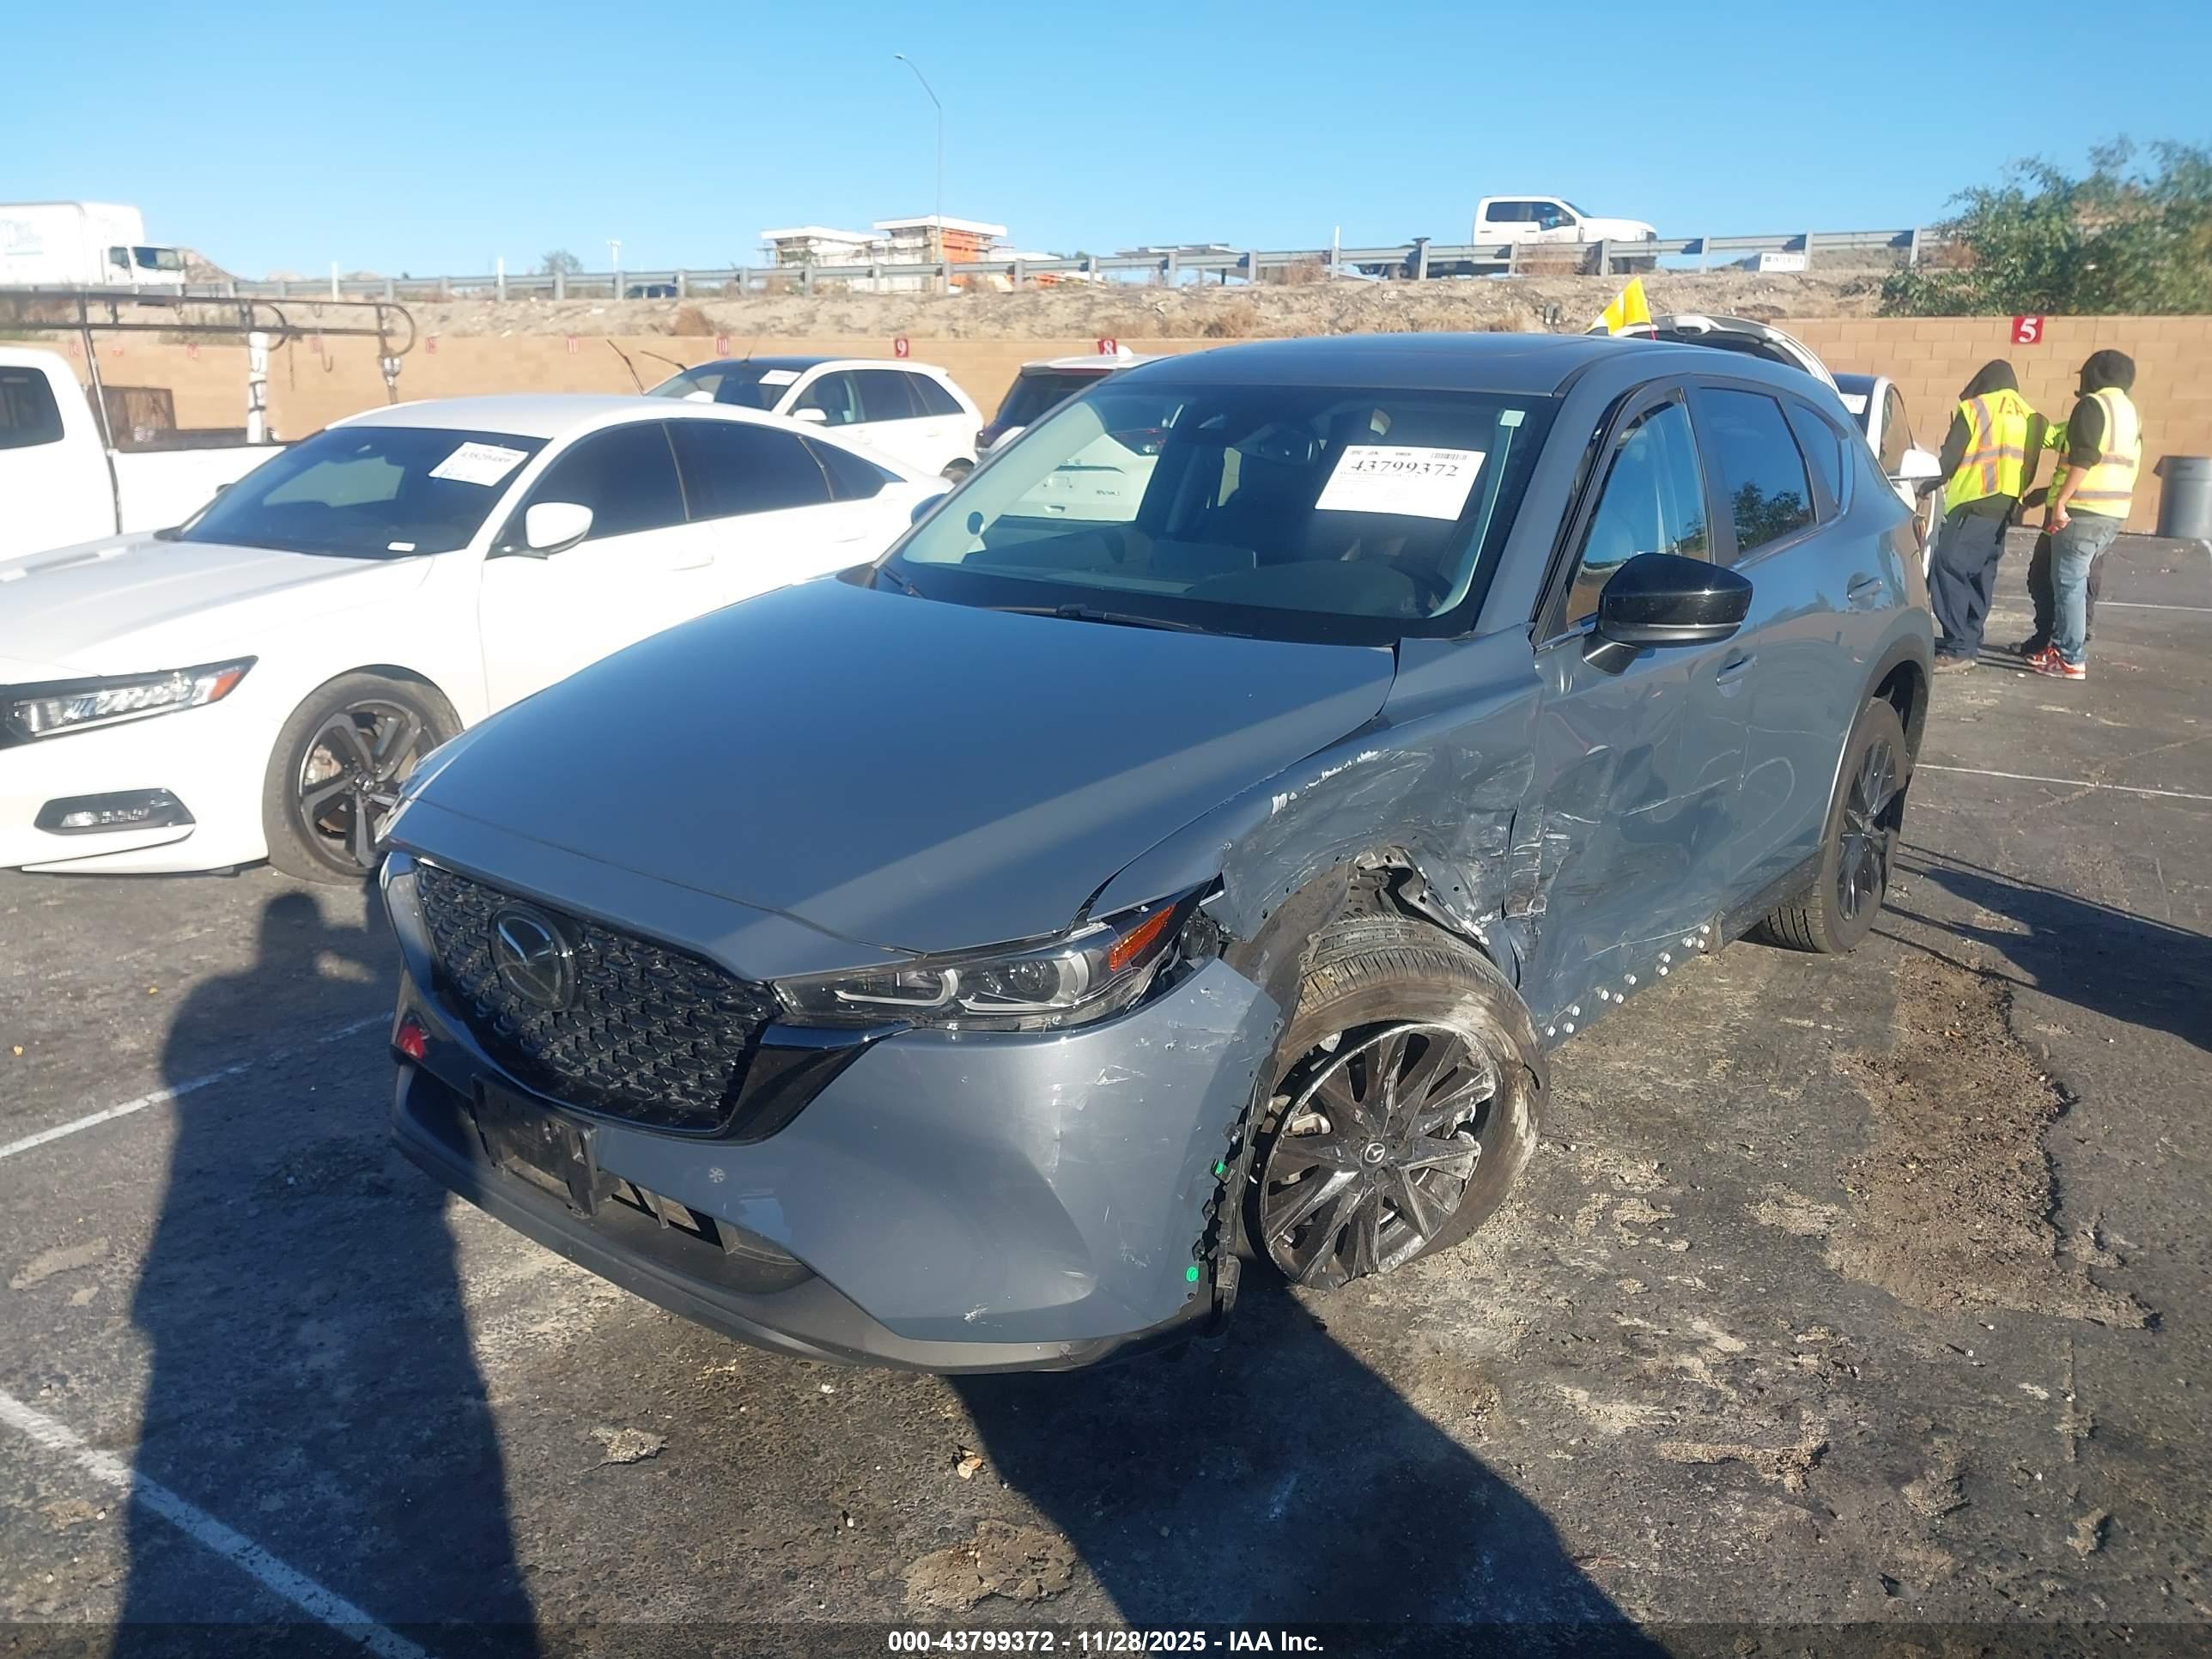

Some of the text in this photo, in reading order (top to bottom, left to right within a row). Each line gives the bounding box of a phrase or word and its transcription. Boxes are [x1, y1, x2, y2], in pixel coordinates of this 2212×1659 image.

[2018, 318, 2038, 343] 5
[896, 339, 908, 356] 9
[1103, 339, 1115, 356] 8
[1350, 459, 1460, 477] 43799372
